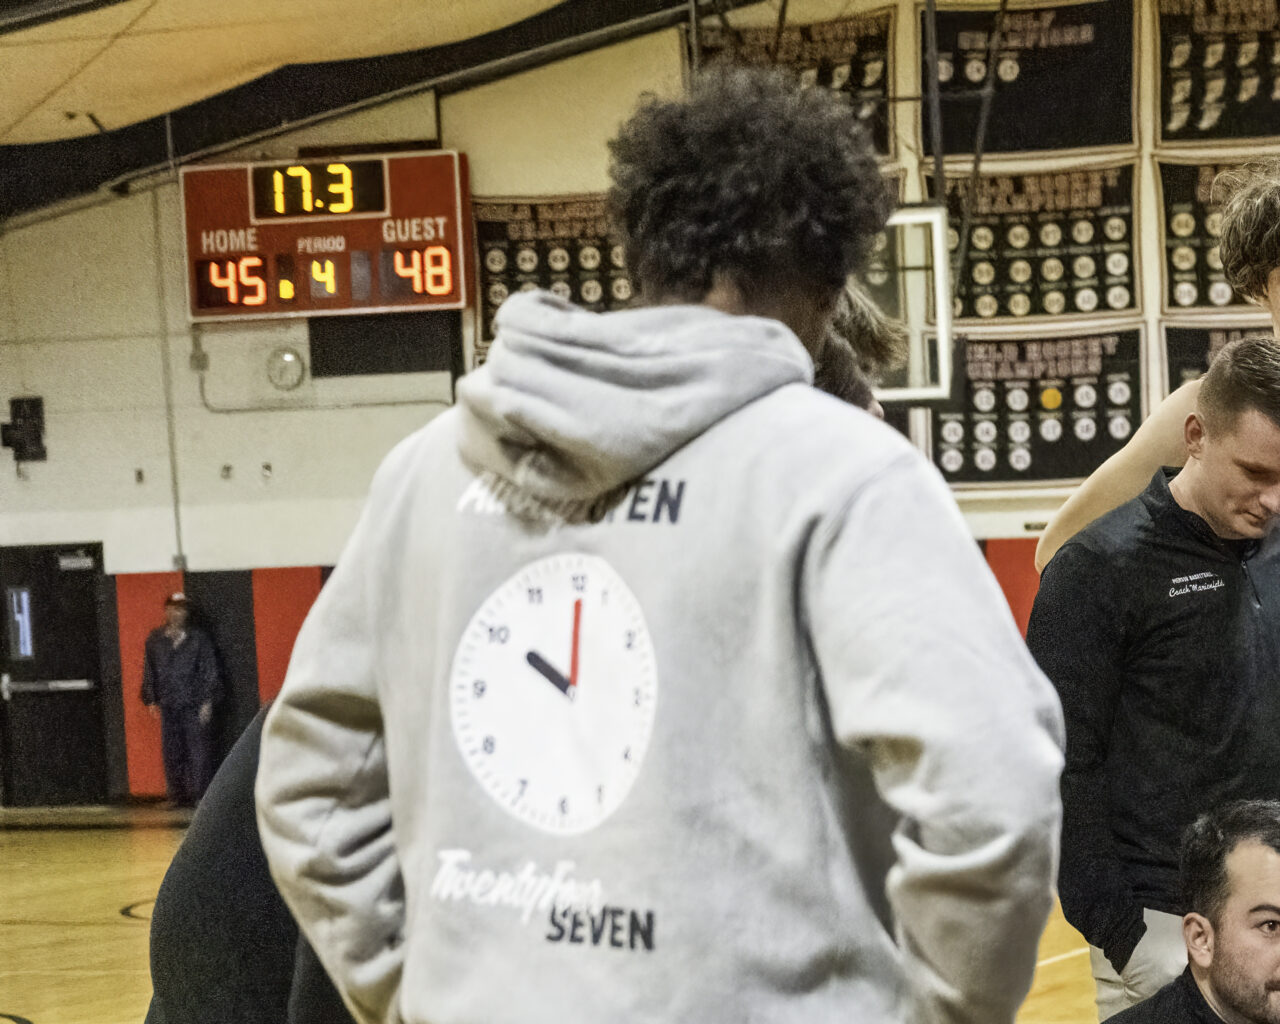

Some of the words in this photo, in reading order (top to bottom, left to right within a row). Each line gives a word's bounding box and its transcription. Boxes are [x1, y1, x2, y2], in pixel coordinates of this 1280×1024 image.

[273, 163, 354, 214] 17.3
[201, 227, 258, 254] HOME
[297, 235, 346, 253] PERIOD
[382, 217, 447, 243] GUEST
[209, 256, 267, 306] 45
[311, 259, 336, 294] 4
[394, 246, 452, 296] 48
[546, 904, 656, 951] SEVEN
